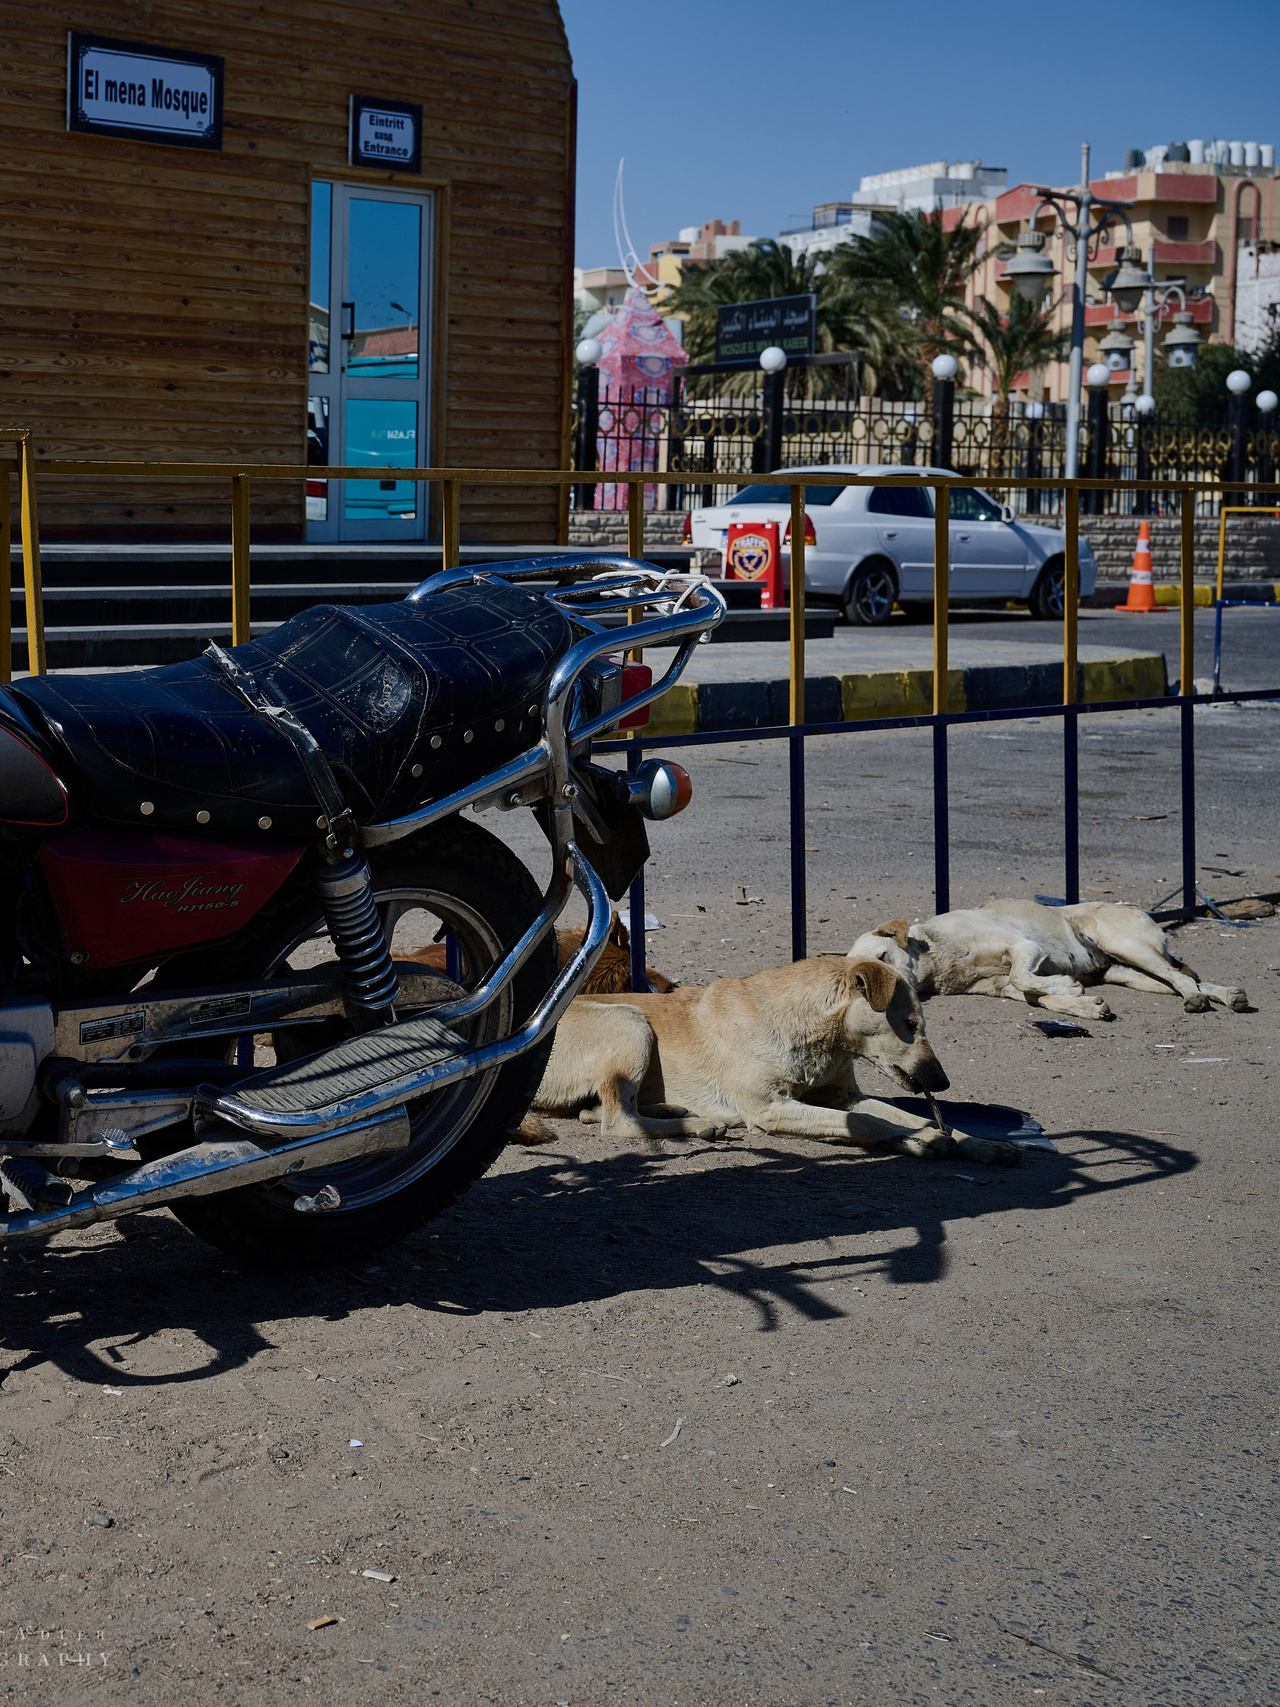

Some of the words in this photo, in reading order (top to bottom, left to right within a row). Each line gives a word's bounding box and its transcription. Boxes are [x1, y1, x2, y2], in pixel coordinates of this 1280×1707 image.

[85, 69, 99, 100] El
[105, 79, 145, 106] mena
[152, 78, 208, 119] Mosque
[369, 114, 404, 130] Eintritt
[364, 141, 408, 157] Entrance
[121, 875, 244, 908] HaoJiang
